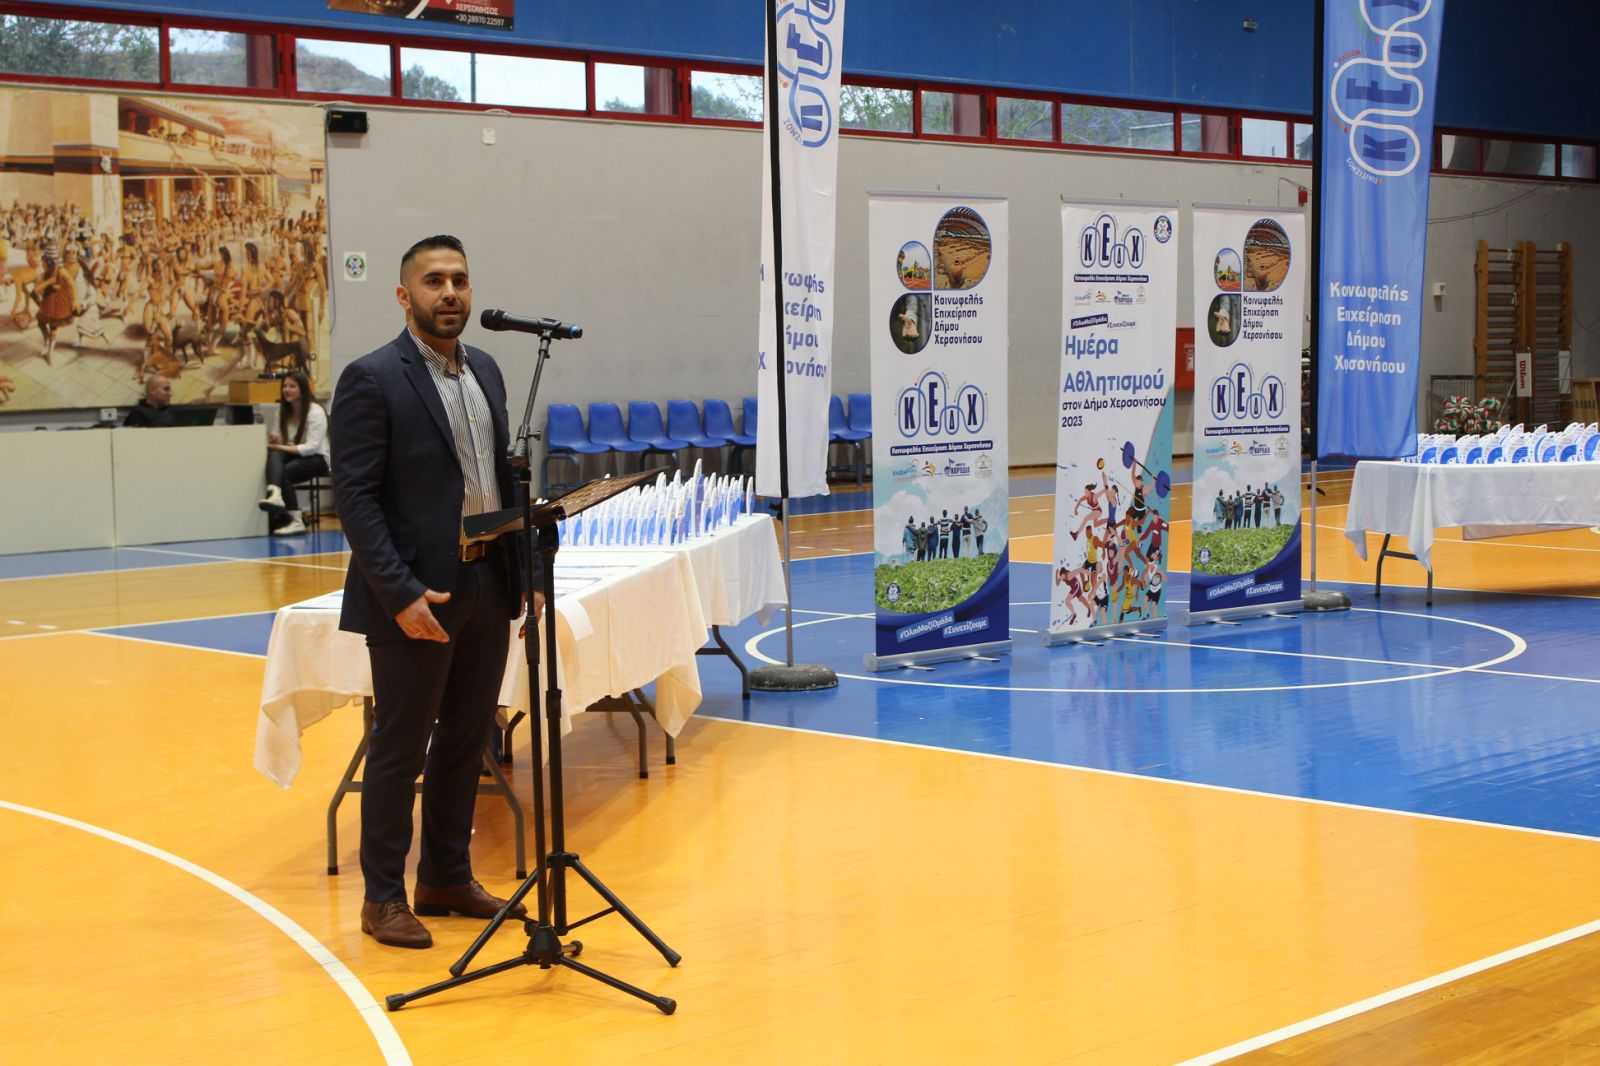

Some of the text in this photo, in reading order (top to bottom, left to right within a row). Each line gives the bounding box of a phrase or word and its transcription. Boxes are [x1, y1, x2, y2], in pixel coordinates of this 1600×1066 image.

[934, 293, 984, 307] Κοινωφελής
[1243, 295, 1283, 306] Κοινωφελής
[934, 307, 977, 321] Επιχείρηση
[1243, 307, 1279, 319] Επιχείρηση
[934, 320, 959, 333] Δήμου
[1243, 318, 1263, 329] Δήμου
[934, 333, 983, 347] Χερσονήσου
[1243, 330, 1283, 341] Χερσονήσου
[1346, 330, 1386, 350] Δήμου
[1065, 333, 1118, 360] Ημέρα
[1519, 360, 1527, 389] Wilson
[1063, 368, 1164, 396] Αθλητισμού
[1062, 396, 1166, 411] στον Δήμο Χερσονήσου
[1061, 416, 1083, 427] 2023
